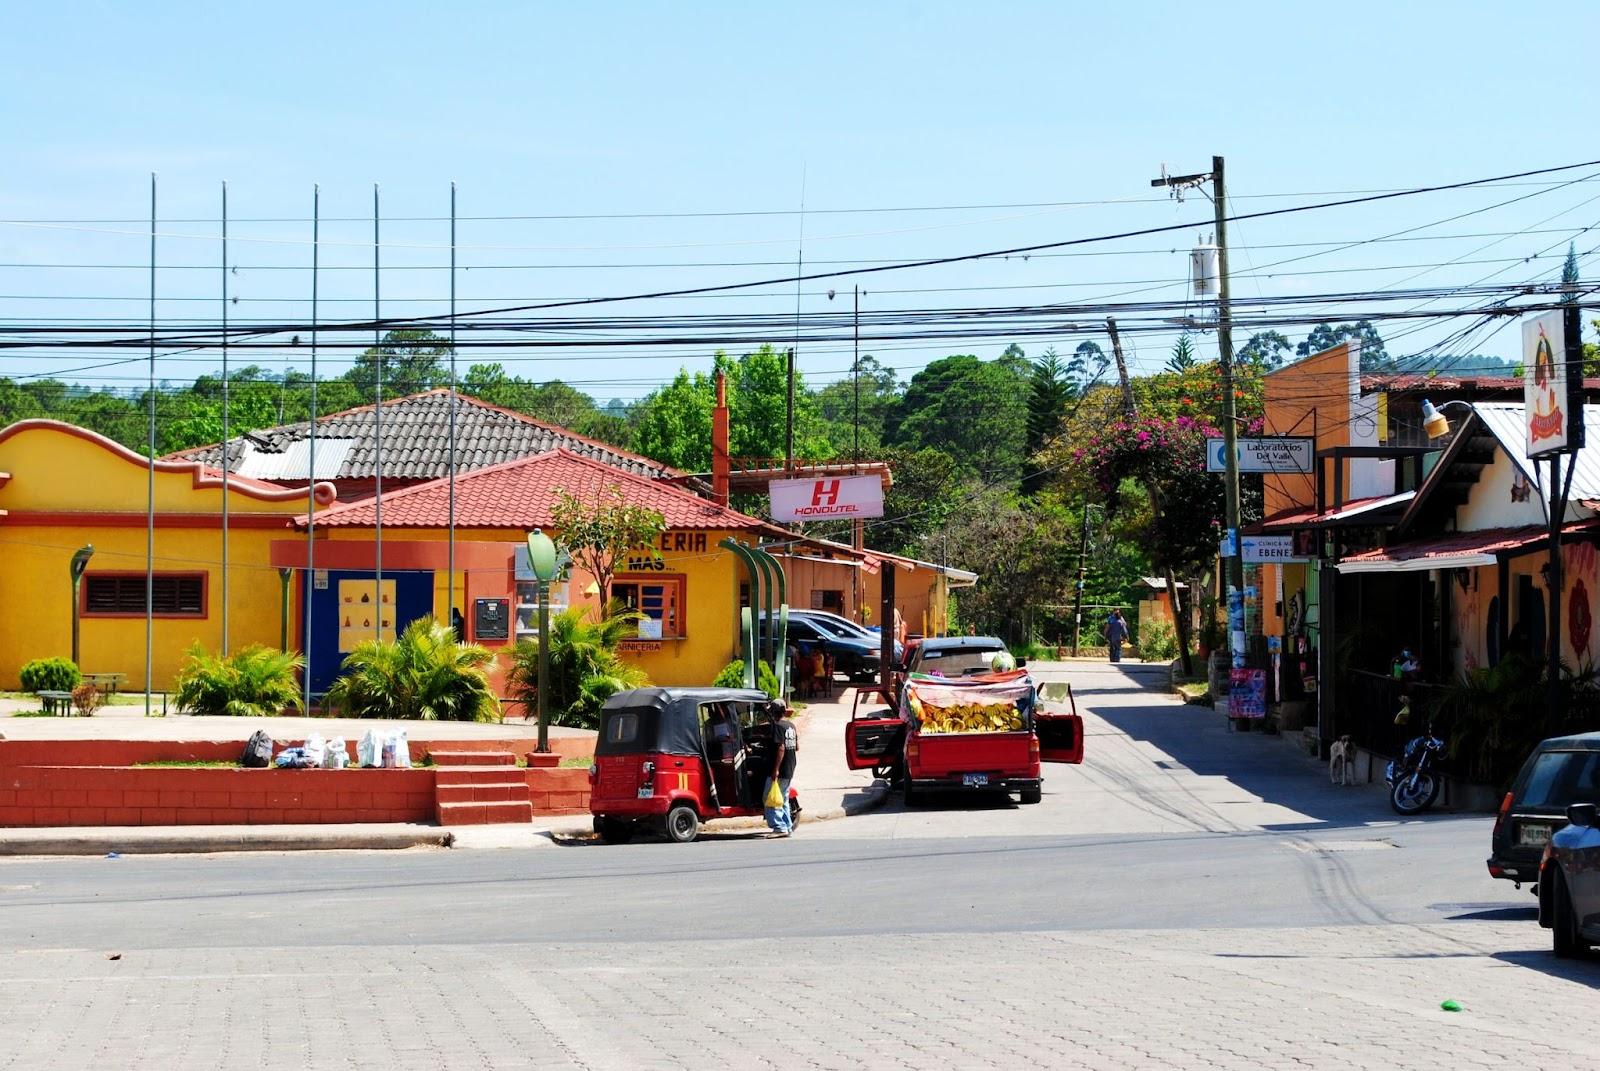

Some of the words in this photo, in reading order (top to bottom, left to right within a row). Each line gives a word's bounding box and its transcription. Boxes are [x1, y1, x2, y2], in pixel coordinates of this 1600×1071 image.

[1247, 443, 1302, 452] Laboratorios
[1256, 452, 1269, 460] Del
[1272, 452, 1291, 460] Valle
[811, 479, 840, 506] H
[795, 505, 859, 515] HONDUTEL
